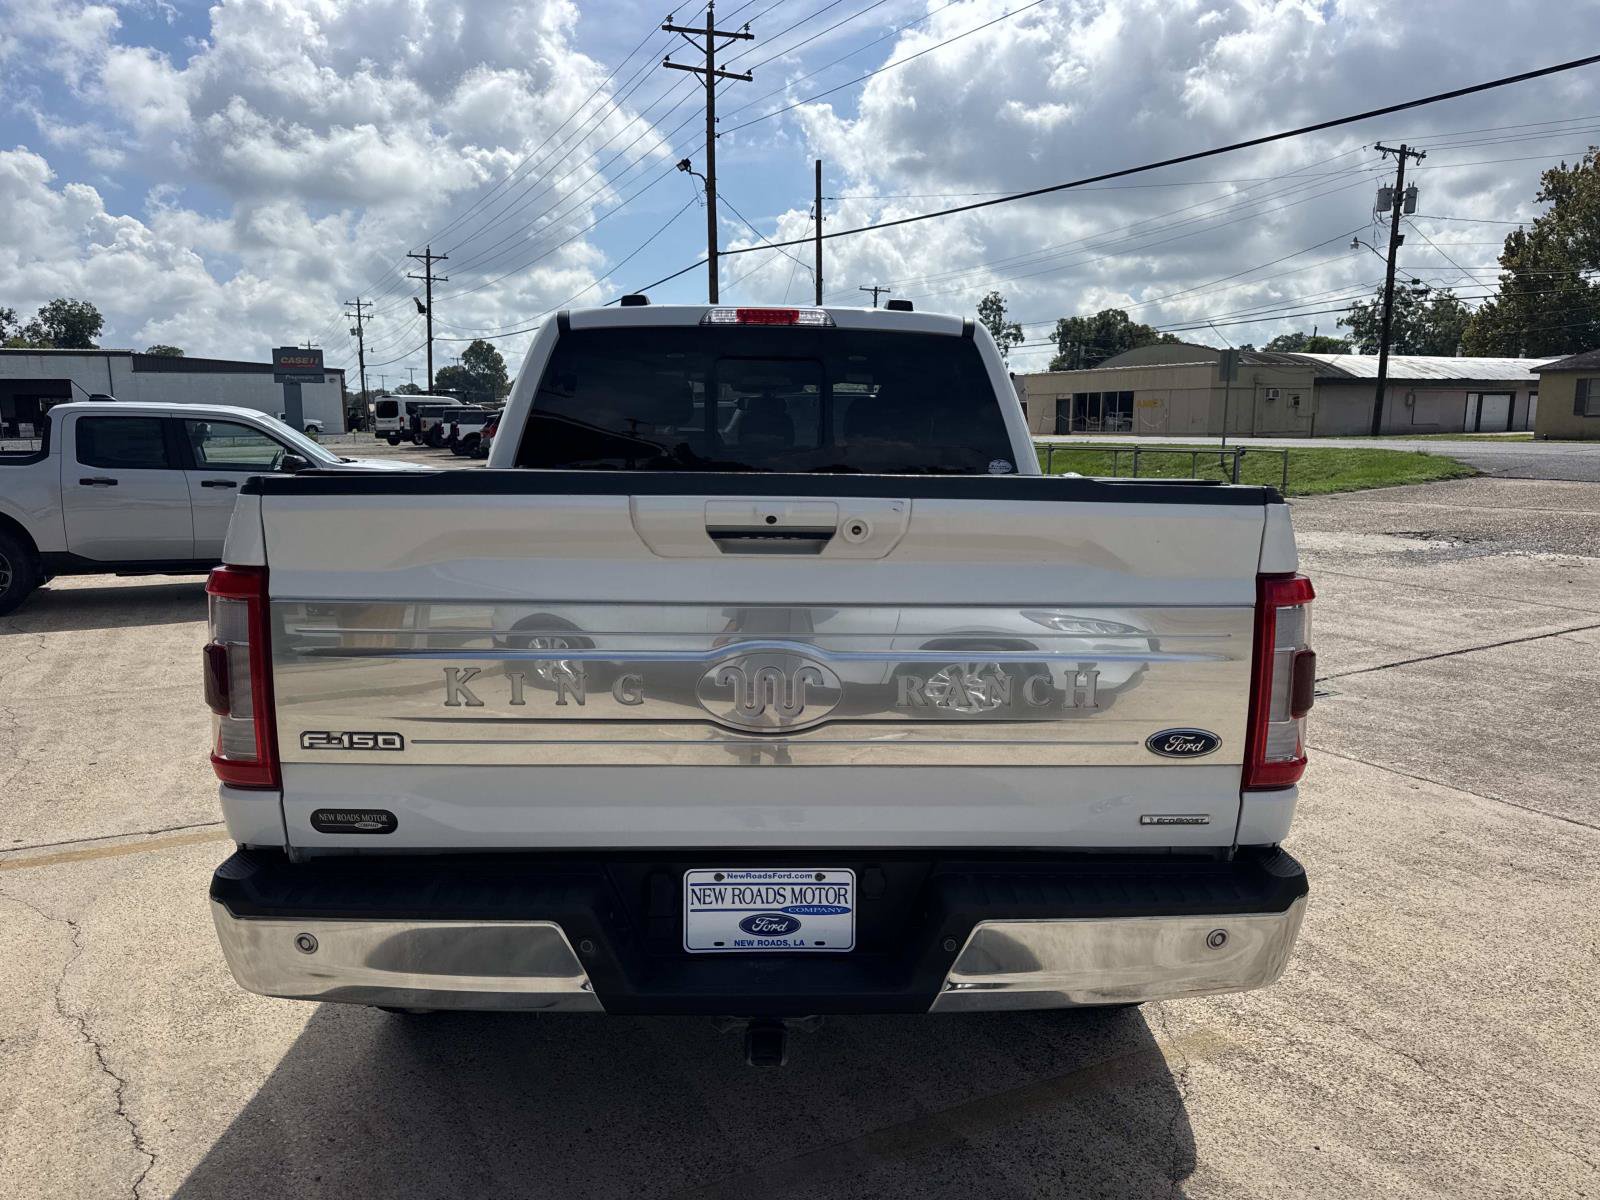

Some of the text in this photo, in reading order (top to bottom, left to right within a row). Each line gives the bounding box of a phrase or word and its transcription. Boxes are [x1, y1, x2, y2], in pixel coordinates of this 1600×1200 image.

[443, 667, 1101, 708] KING RANCH
[301, 731, 404, 750] F-150
[1164, 735, 1206, 752] Ford
[318, 813, 388, 822] NEW ROADS MOTOR
[726, 872, 813, 880] NewRoadsFord.com
[690, 886, 849, 905] NEW ROADS MOTOR
[752, 917, 789, 932] Ford
[734, 939, 754, 947] NEW
[757, 939, 791, 947] ROADS,
